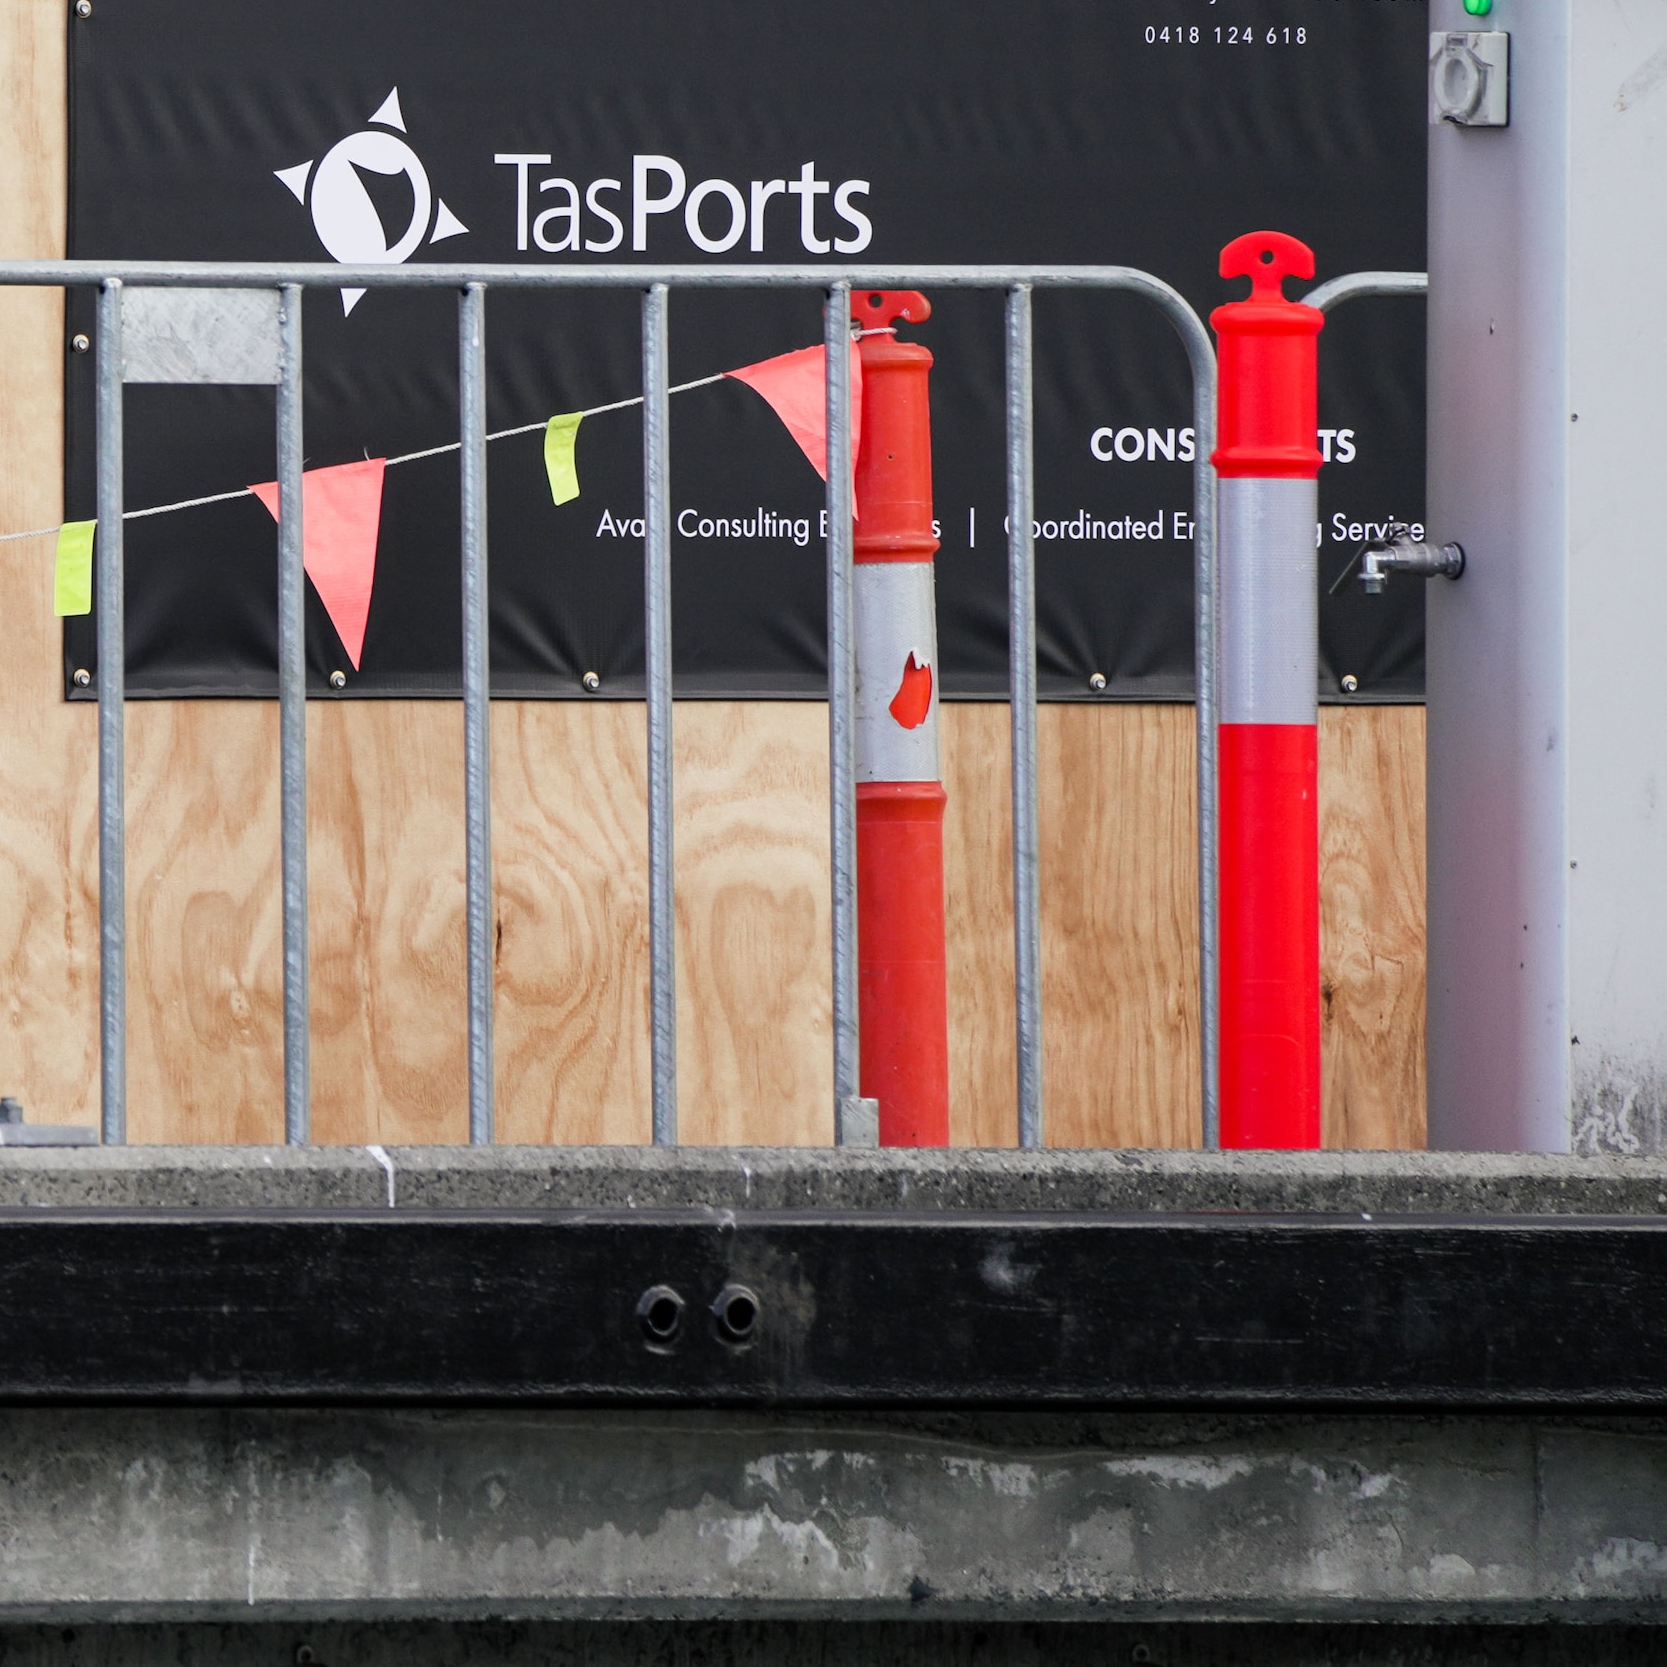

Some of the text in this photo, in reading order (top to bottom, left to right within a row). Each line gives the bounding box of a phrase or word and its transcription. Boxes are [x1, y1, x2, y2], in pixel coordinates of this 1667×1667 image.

[1144, 25, 1307, 46] 0418 124 618
[494, 153, 873, 254] TasPorts
[1090, 426, 1357, 464] CONSTS
[595, 508, 645, 538] Ava
[677, 506, 810, 547] Consulting
